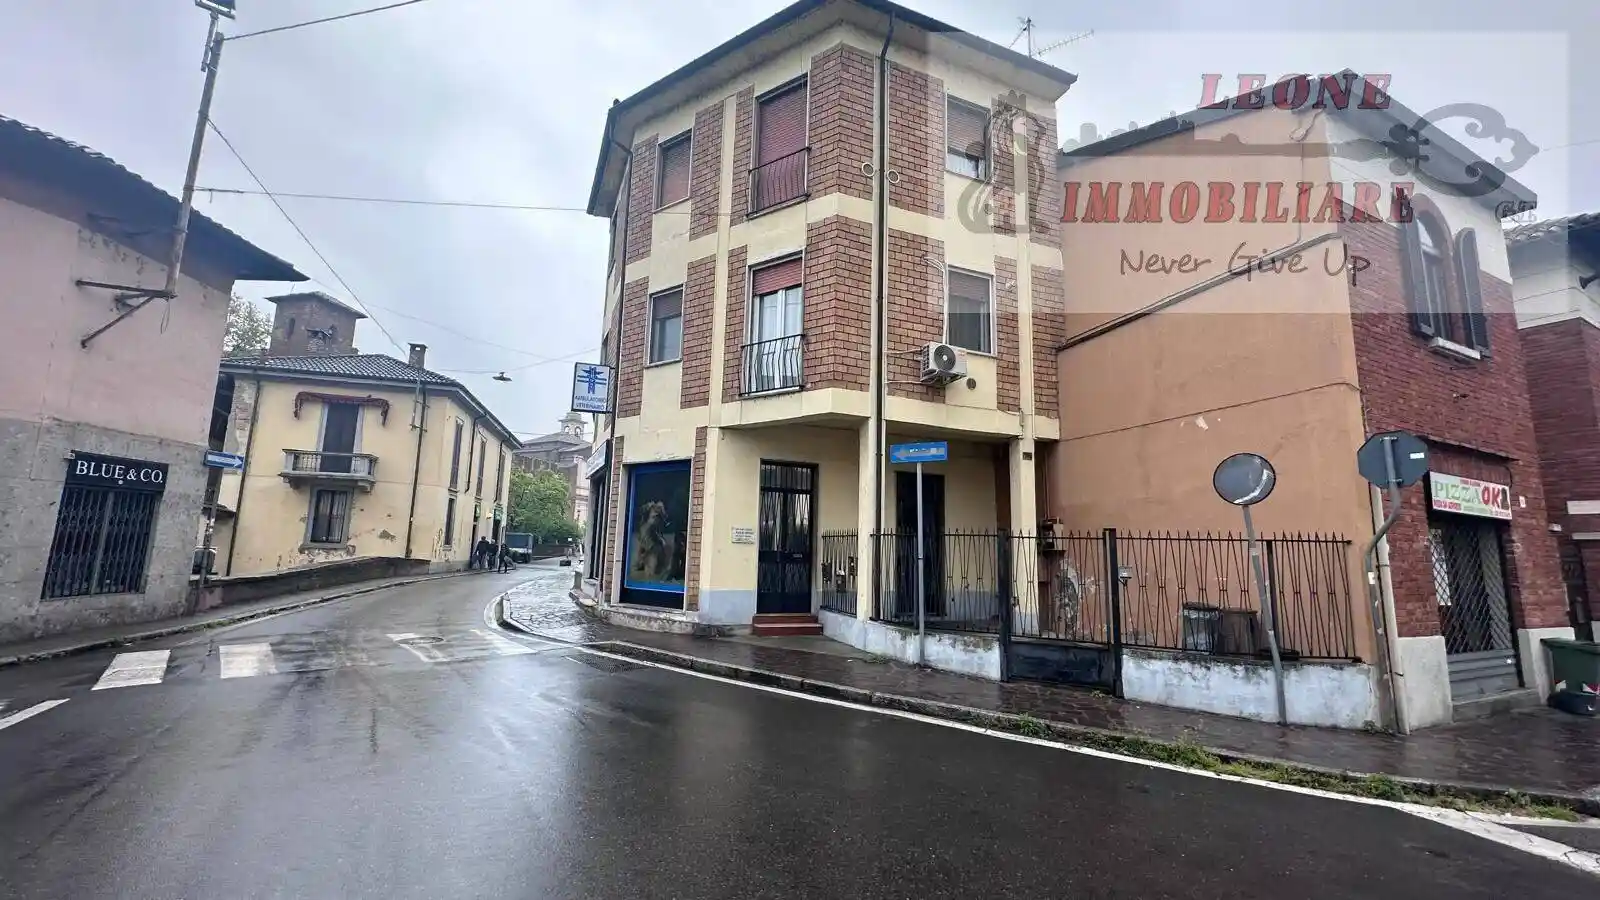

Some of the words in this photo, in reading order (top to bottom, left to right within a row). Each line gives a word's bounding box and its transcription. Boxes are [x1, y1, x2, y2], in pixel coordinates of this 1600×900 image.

[75, 460, 125, 479] BLUE
[1434, 480, 1480, 505] PIZZA
[1481, 485, 1501, 509] OK
